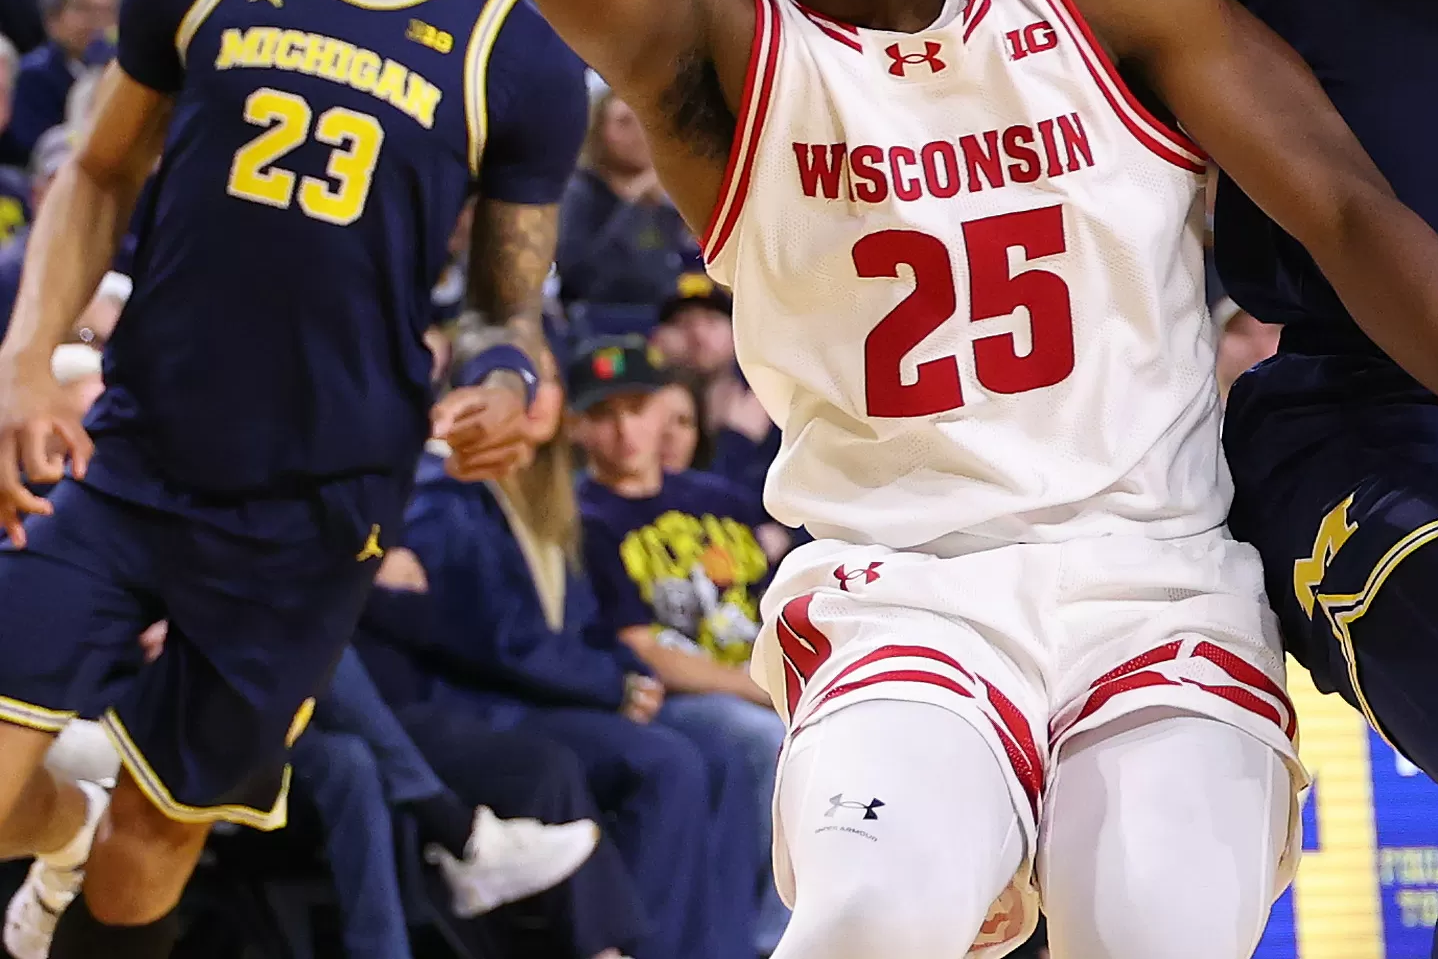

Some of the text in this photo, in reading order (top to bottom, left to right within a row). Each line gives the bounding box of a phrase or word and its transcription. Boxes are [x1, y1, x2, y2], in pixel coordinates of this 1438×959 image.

[216, 27, 442, 129] MICHIGAN
[226, 87, 386, 227] 23
[793, 113, 1094, 202] WSCONSIN
[852, 205, 1077, 419] 25
[839, 826, 879, 843] ARMOUR
